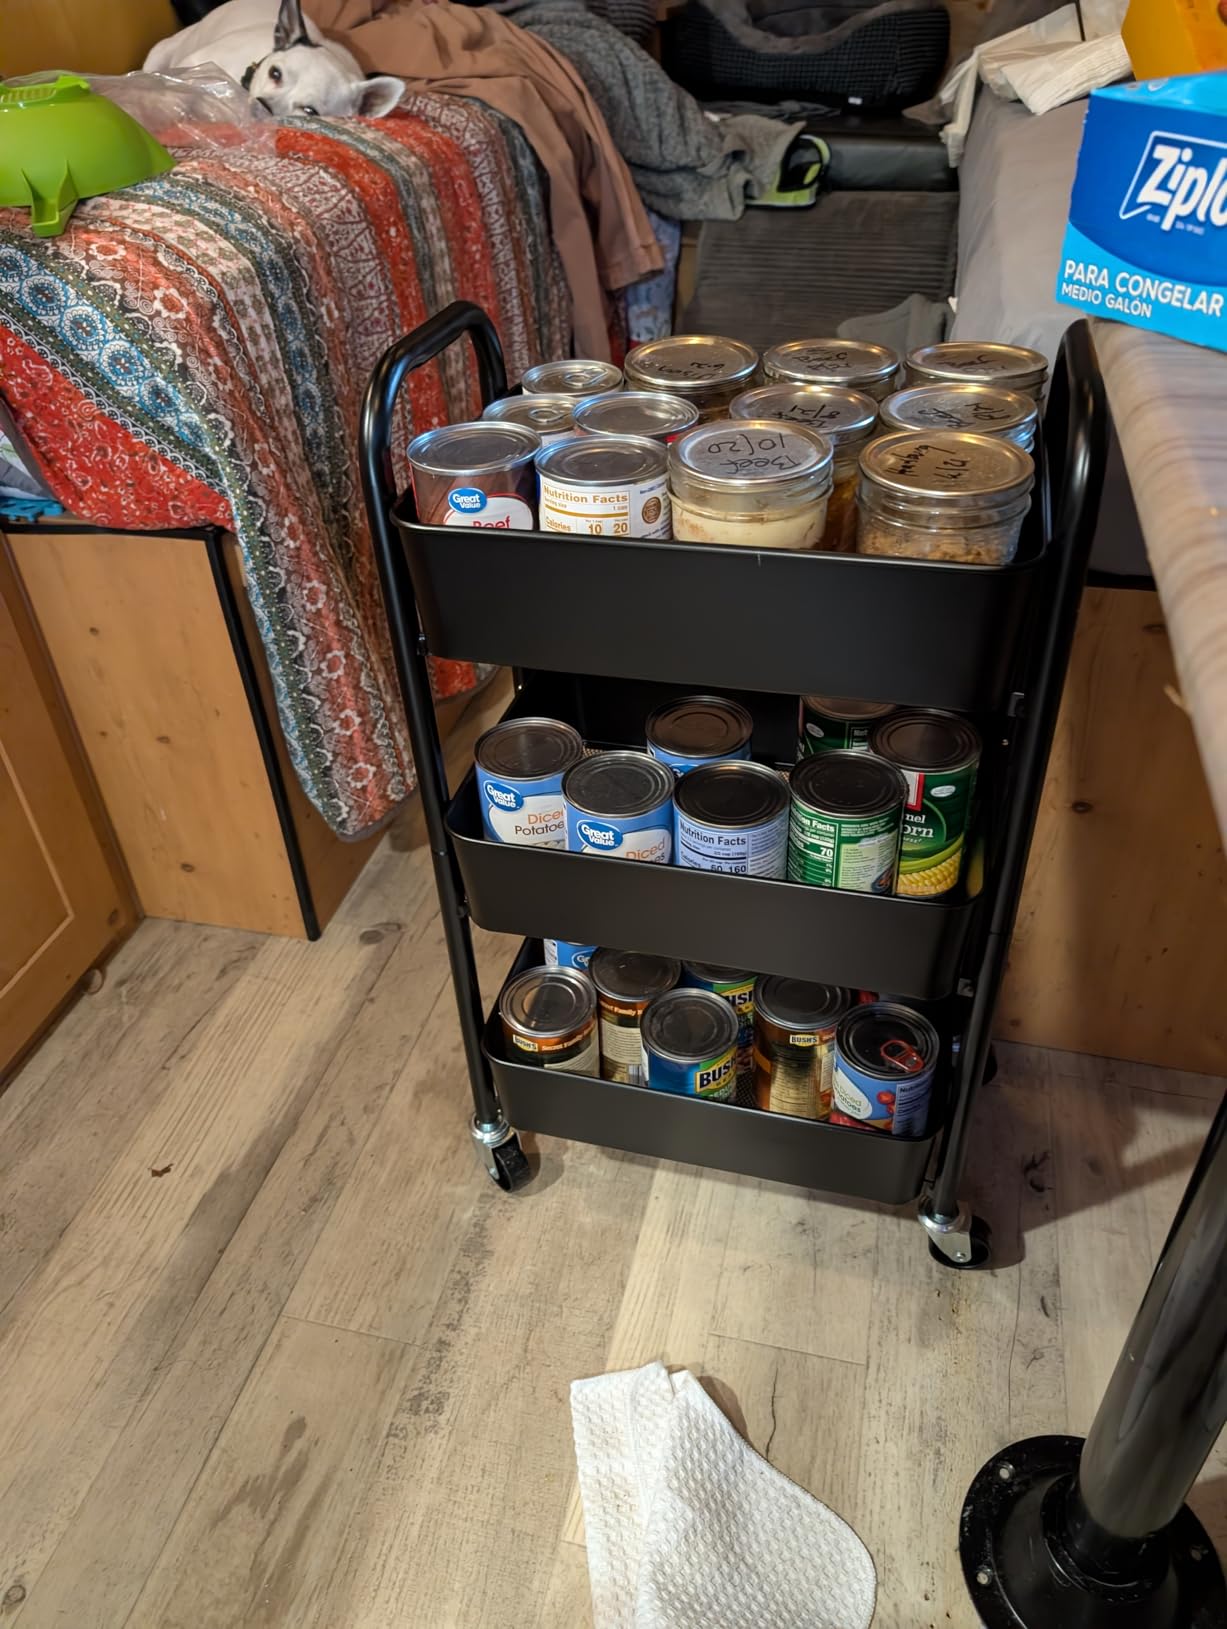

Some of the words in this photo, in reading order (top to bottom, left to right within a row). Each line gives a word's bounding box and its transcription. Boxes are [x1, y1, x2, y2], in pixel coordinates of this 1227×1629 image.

[1064, 259, 1109, 289] PARA
[1115, 272, 1224, 317] CONGELAR
[1061, 282, 1102, 305] MEDIO
[1105, 293, 1153, 318] GALÓN
[452, 493, 481, 503] Great
[544, 485, 588, 503] Nutrition
[592, 495, 628, 504] Facts
[460, 501, 481, 509] Value
[589, 523, 602, 534] 10
[613, 522, 628, 533] 20
[486, 784, 516, 803] Great
[495, 799, 517, 808] Value
[580, 823, 615, 841] Great
[812, 820, 835, 833] Facts
[680, 820, 715, 845] Nutrition
[717, 836, 747, 847] Facts
[589, 836, 615, 847] Value
[820, 847, 834, 857] 70
